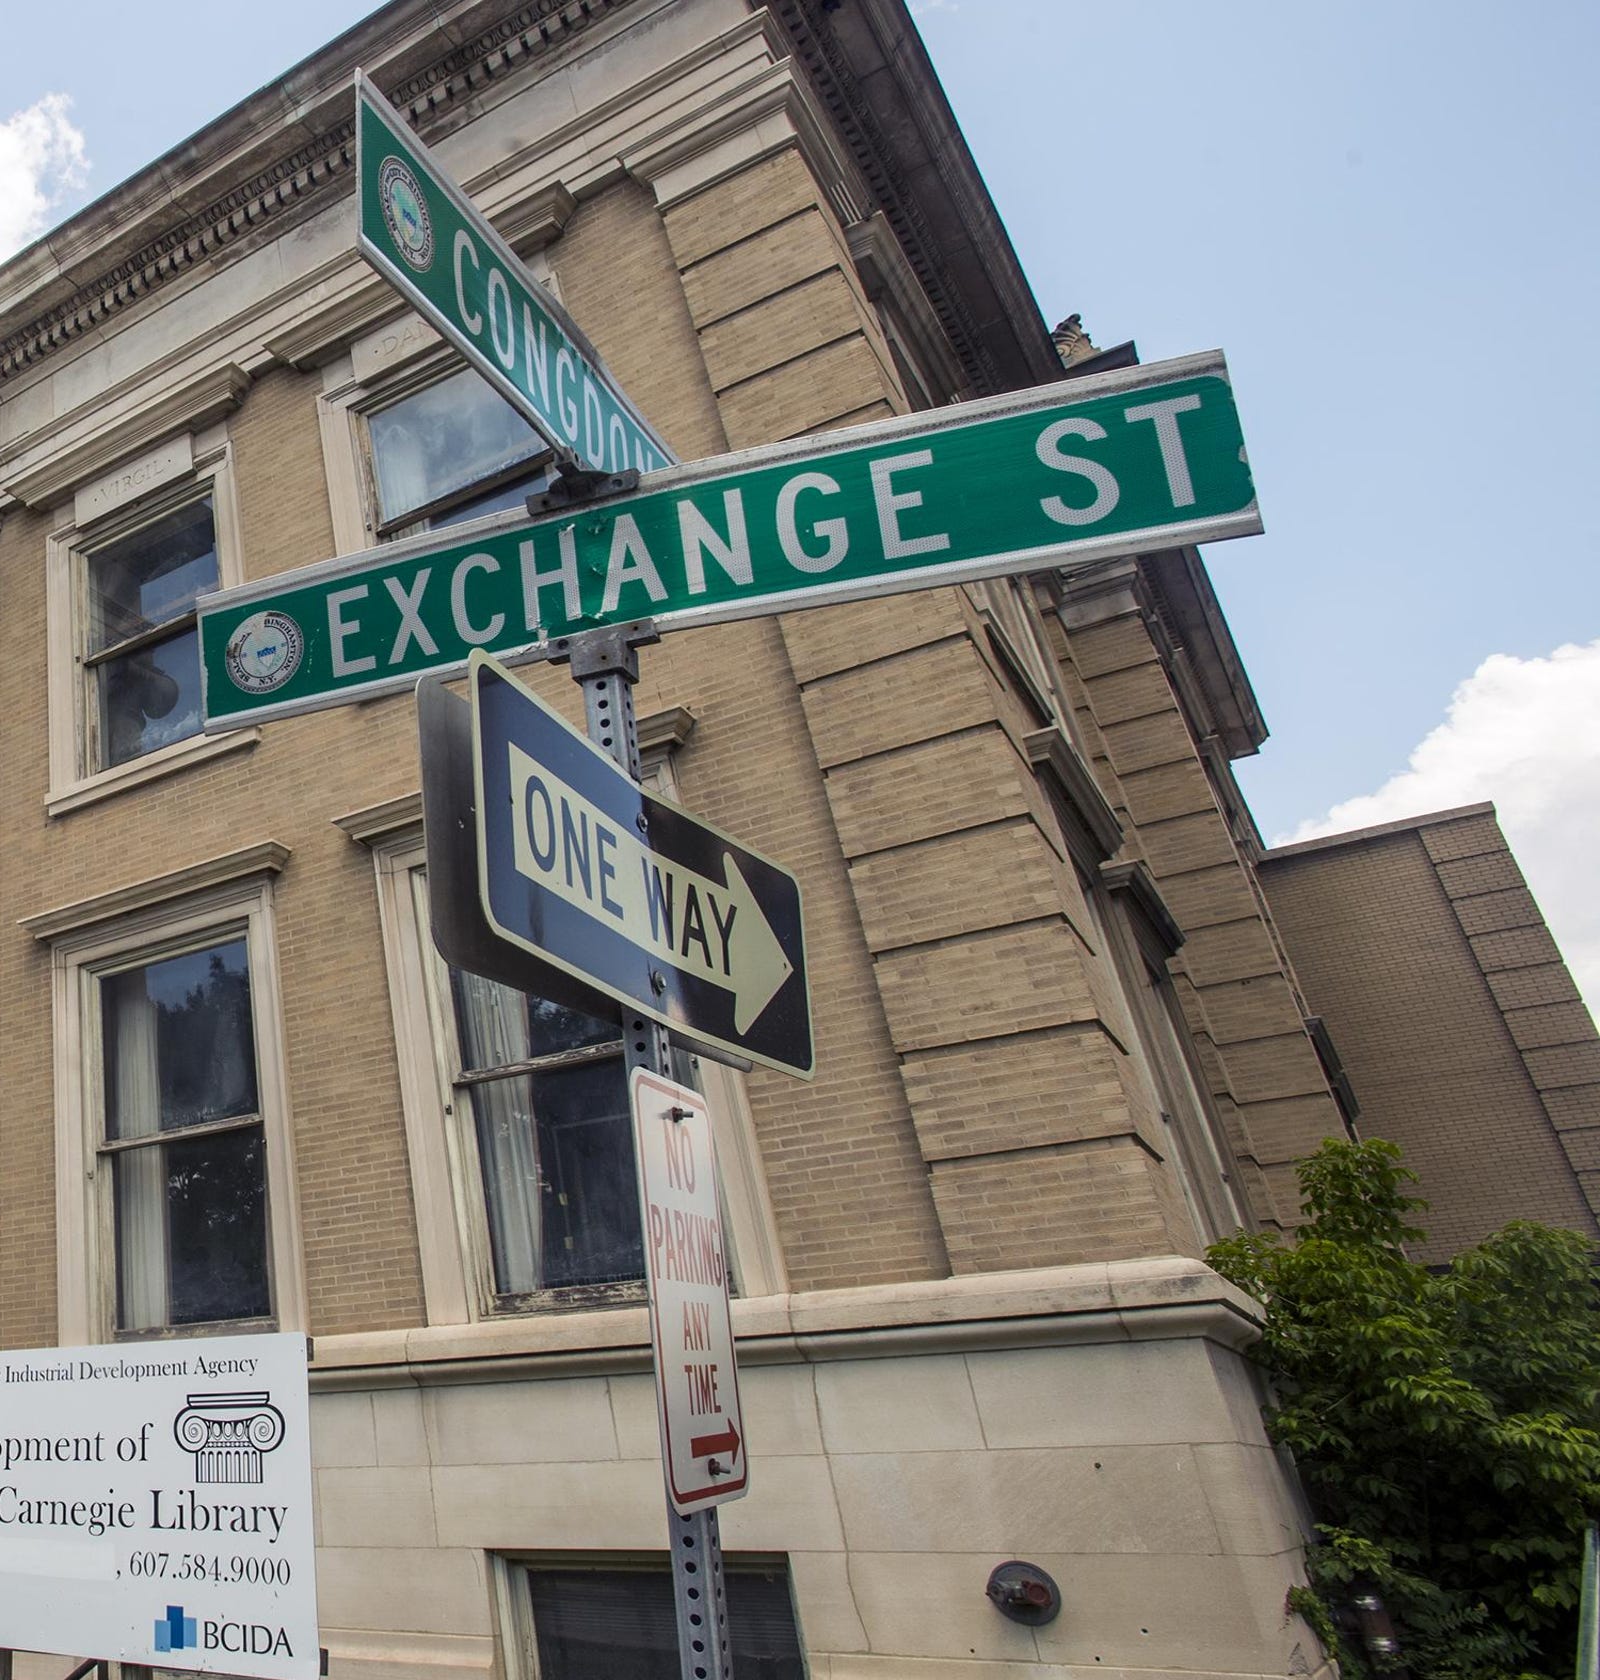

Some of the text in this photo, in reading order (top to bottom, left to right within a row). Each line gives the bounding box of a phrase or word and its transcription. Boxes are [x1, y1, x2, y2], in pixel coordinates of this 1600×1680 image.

[326, 394, 1202, 679] EXCHANGE ST
[526, 775, 737, 977] ONE WAY
[663, 1127, 696, 1195] NO
[650, 1203, 723, 1287] PARKING
[683, 1301, 711, 1352] ANY
[5, 1363, 74, 1383] Industrial
[79, 1359, 188, 1382] Development
[193, 1355, 258, 1379] Agency
[684, 1365, 722, 1416] TIME
[116, 1422, 154, 1462] of
[149, 1489, 288, 1543] Library
[129, 1551, 291, 1586] 607.584.9000
[203, 1620, 294, 1658] BCIDA
